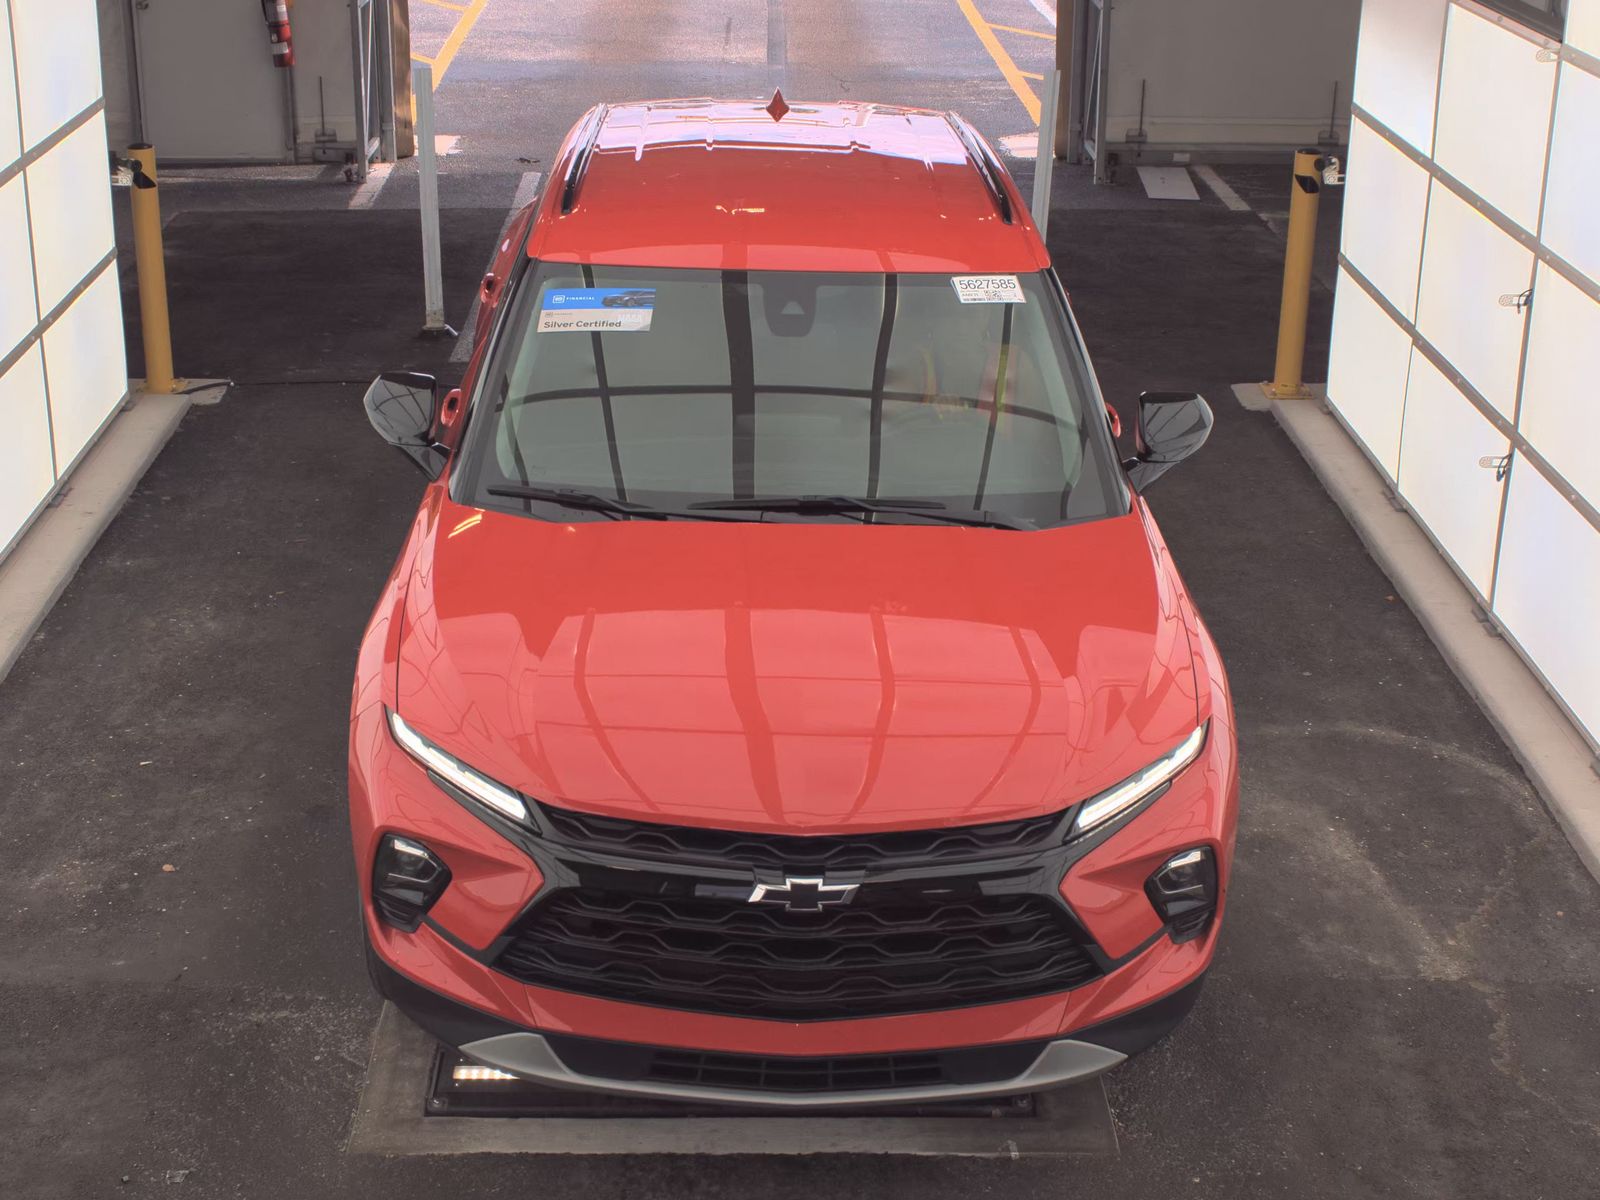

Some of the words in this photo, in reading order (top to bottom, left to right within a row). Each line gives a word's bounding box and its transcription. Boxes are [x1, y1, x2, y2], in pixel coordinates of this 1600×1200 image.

[959, 279, 1016, 290] 5627585
[543, 321, 574, 329] Silver
[576, 320, 622, 328] Certified
